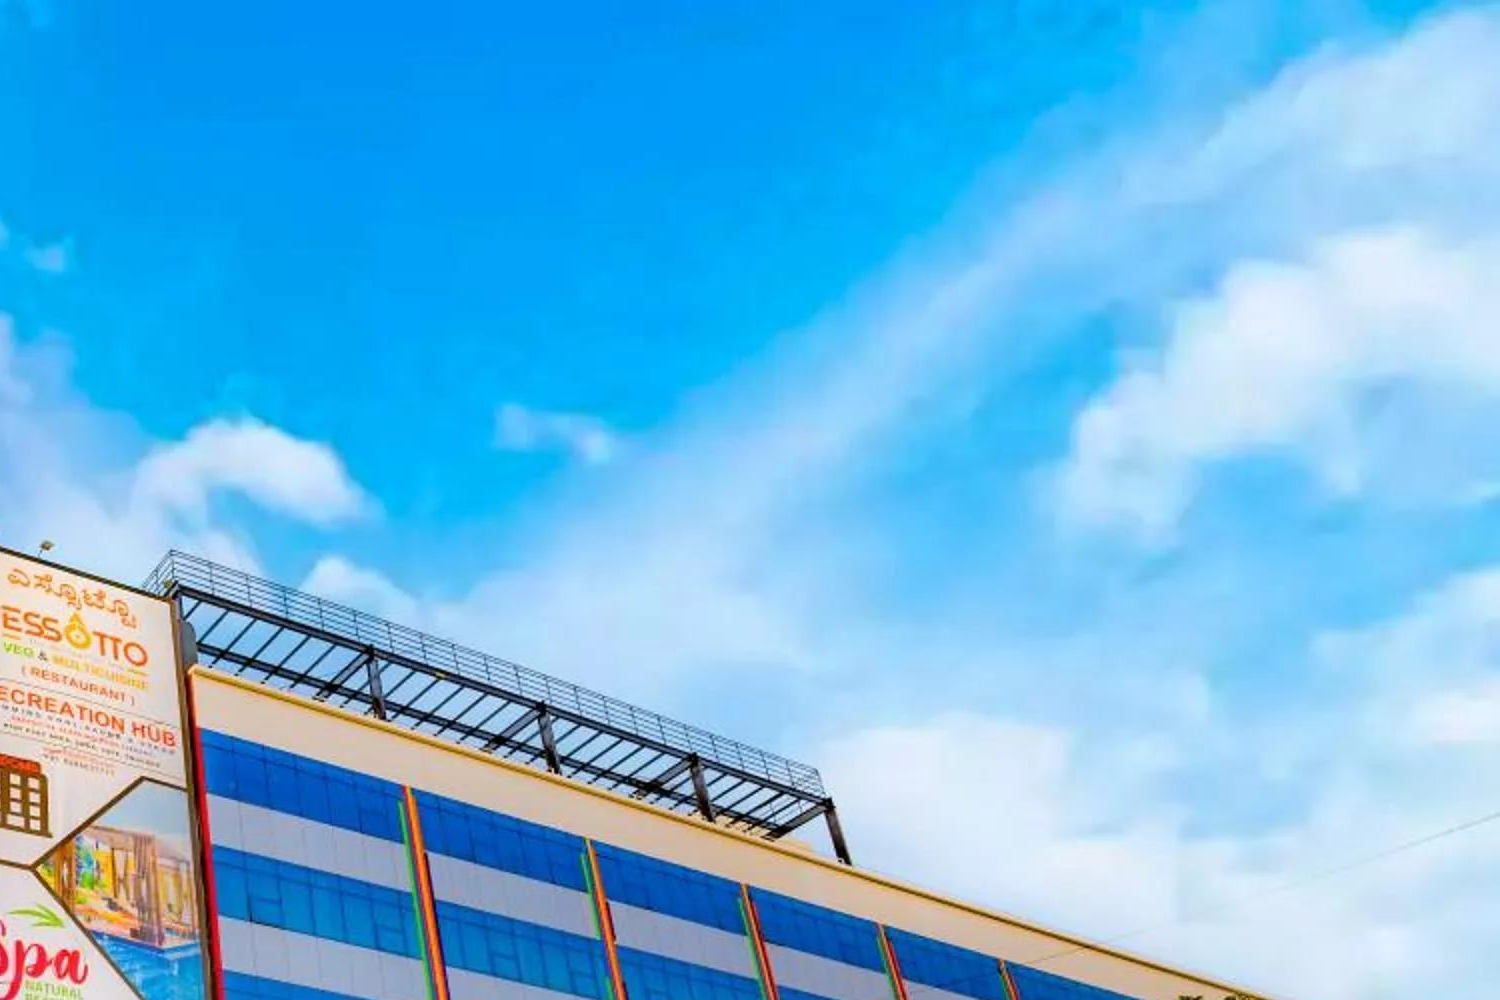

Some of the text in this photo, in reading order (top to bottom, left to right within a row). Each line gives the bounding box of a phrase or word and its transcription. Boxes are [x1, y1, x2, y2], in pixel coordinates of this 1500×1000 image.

[1, 605, 148, 667] ESSOTTO
[3, 641, 34, 658] VEG
[37, 651, 48, 662] &
[131, 721, 177, 747] HUB
[24, 979, 84, 1000] NATURAL
